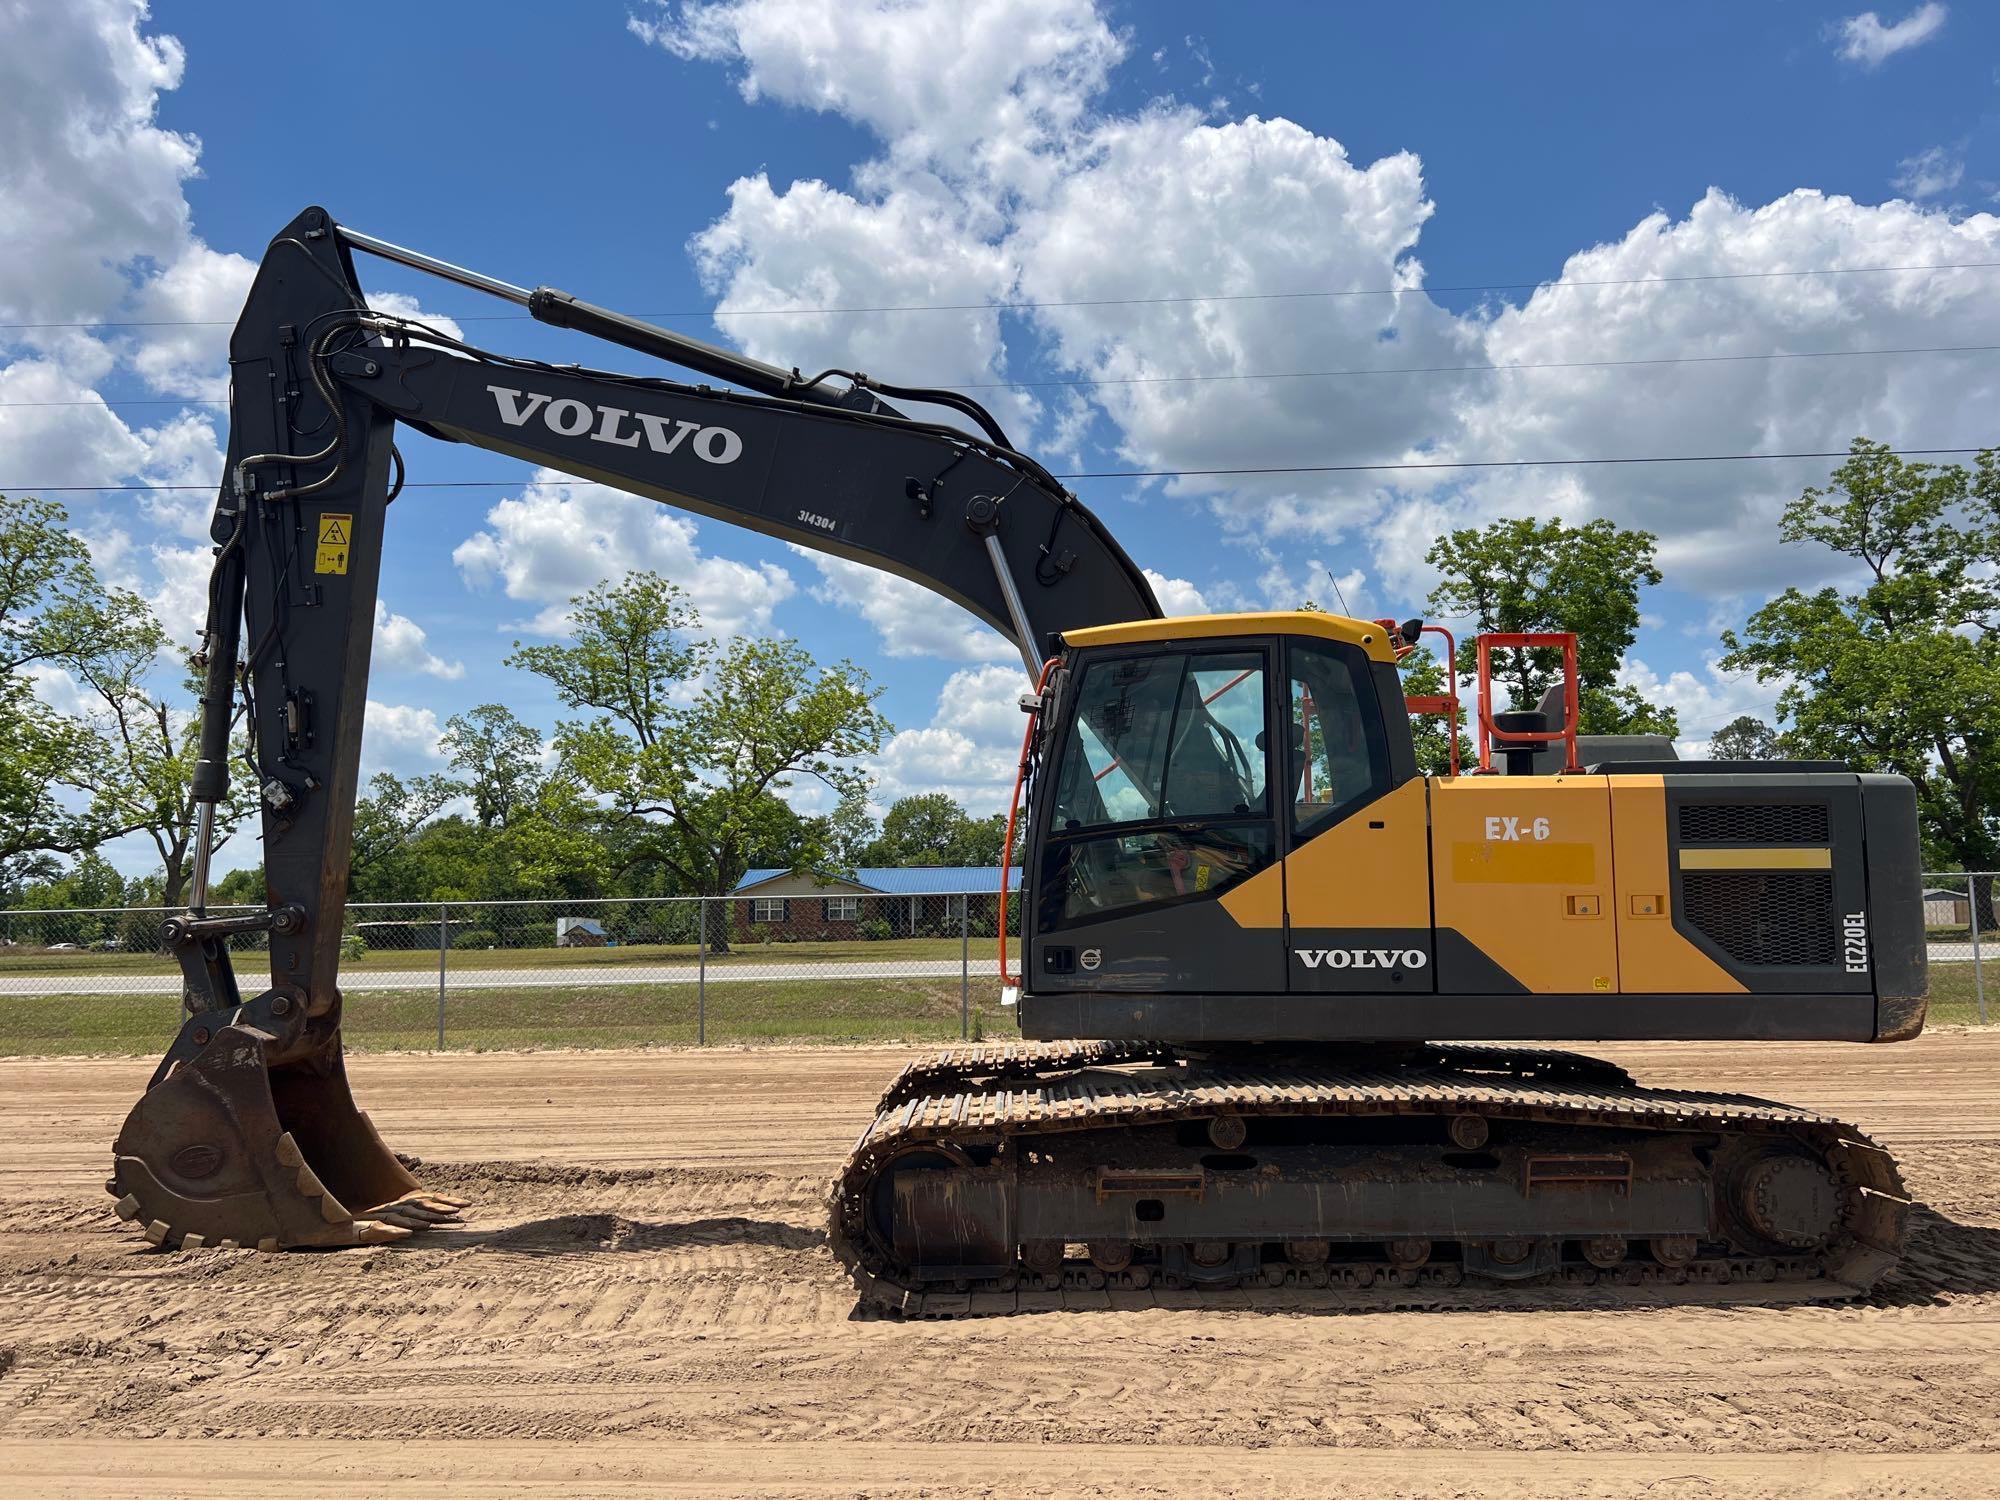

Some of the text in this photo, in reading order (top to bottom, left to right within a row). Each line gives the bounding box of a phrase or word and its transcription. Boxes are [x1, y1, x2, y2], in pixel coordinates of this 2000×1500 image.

[486, 385, 743, 464] VOLVO
[797, 510, 836, 531] 314304
[1485, 816, 1550, 841] EX-6
[1843, 911, 1868, 973] EC220EL
[1294, 949, 1427, 969] VOLVO
